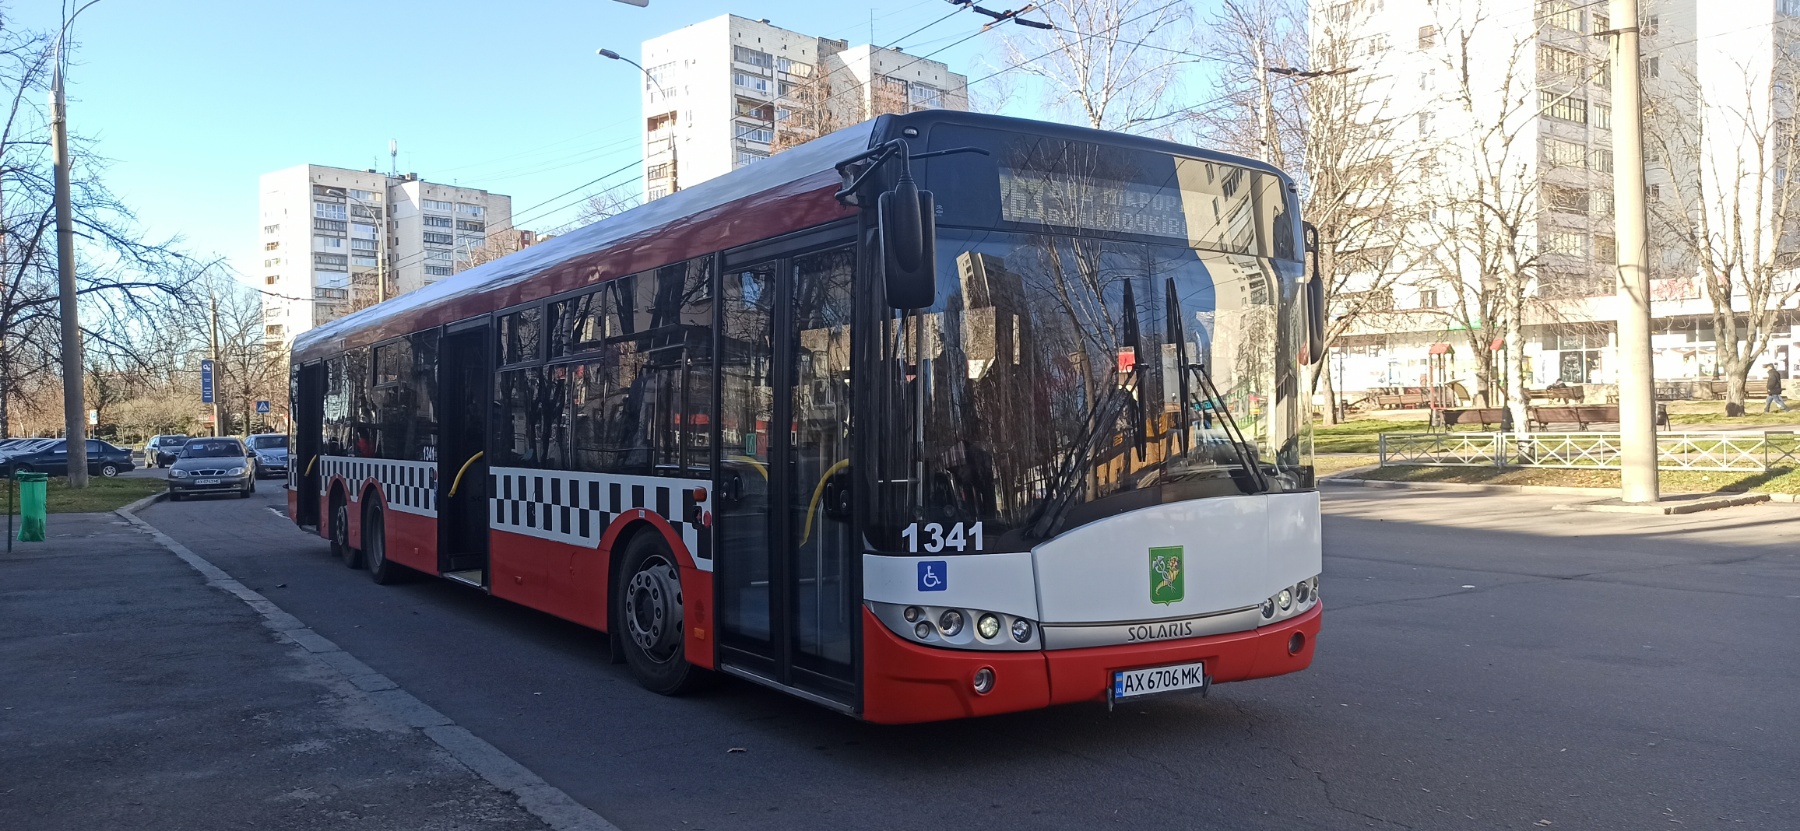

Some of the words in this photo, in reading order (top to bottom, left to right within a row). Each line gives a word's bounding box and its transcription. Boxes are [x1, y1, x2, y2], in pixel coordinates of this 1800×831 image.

[902, 521, 983, 553] 1341
[1127, 621, 1193, 642] SOLARIS
[1124, 673, 1145, 693] AX
[1147, 669, 1179, 690] 6706
[1181, 666, 1201, 686] MK
